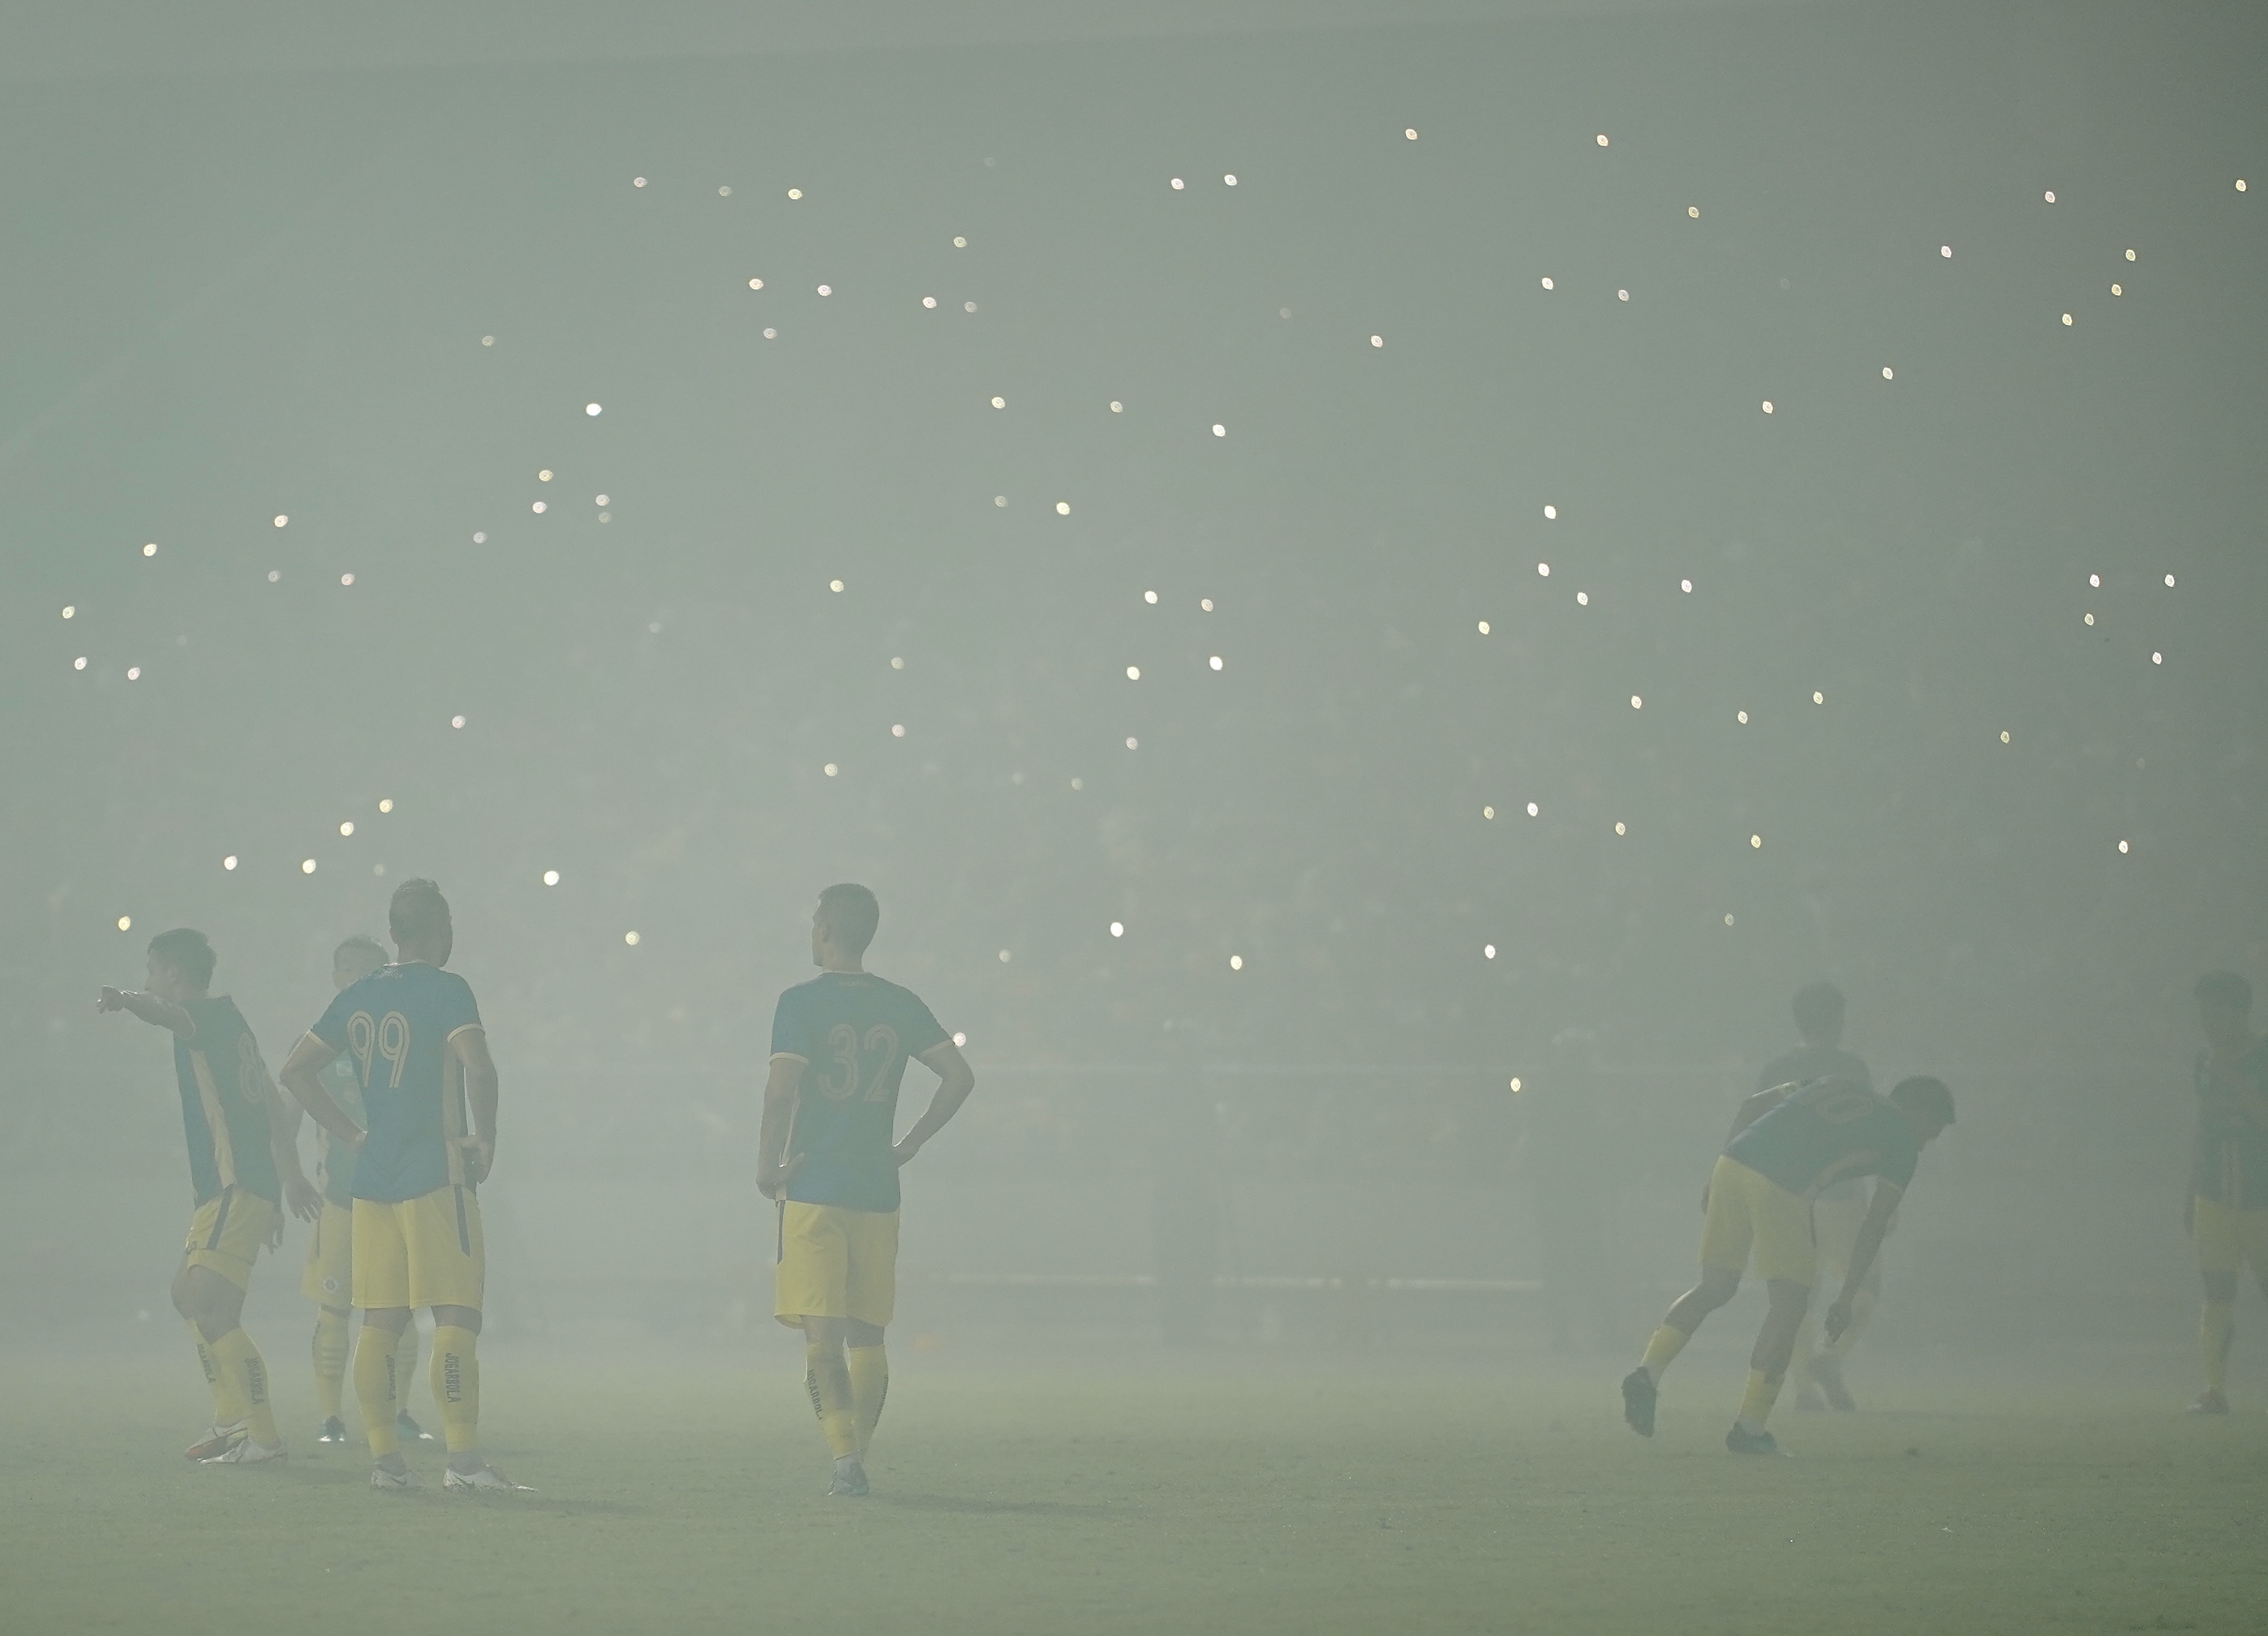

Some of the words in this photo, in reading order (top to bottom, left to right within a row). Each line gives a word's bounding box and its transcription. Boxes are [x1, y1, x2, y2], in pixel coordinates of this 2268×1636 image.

[347, 1011, 410, 1088] 99
[817, 1023, 900, 1102] 32
[445, 1352, 462, 1403] JOGARBOLA
